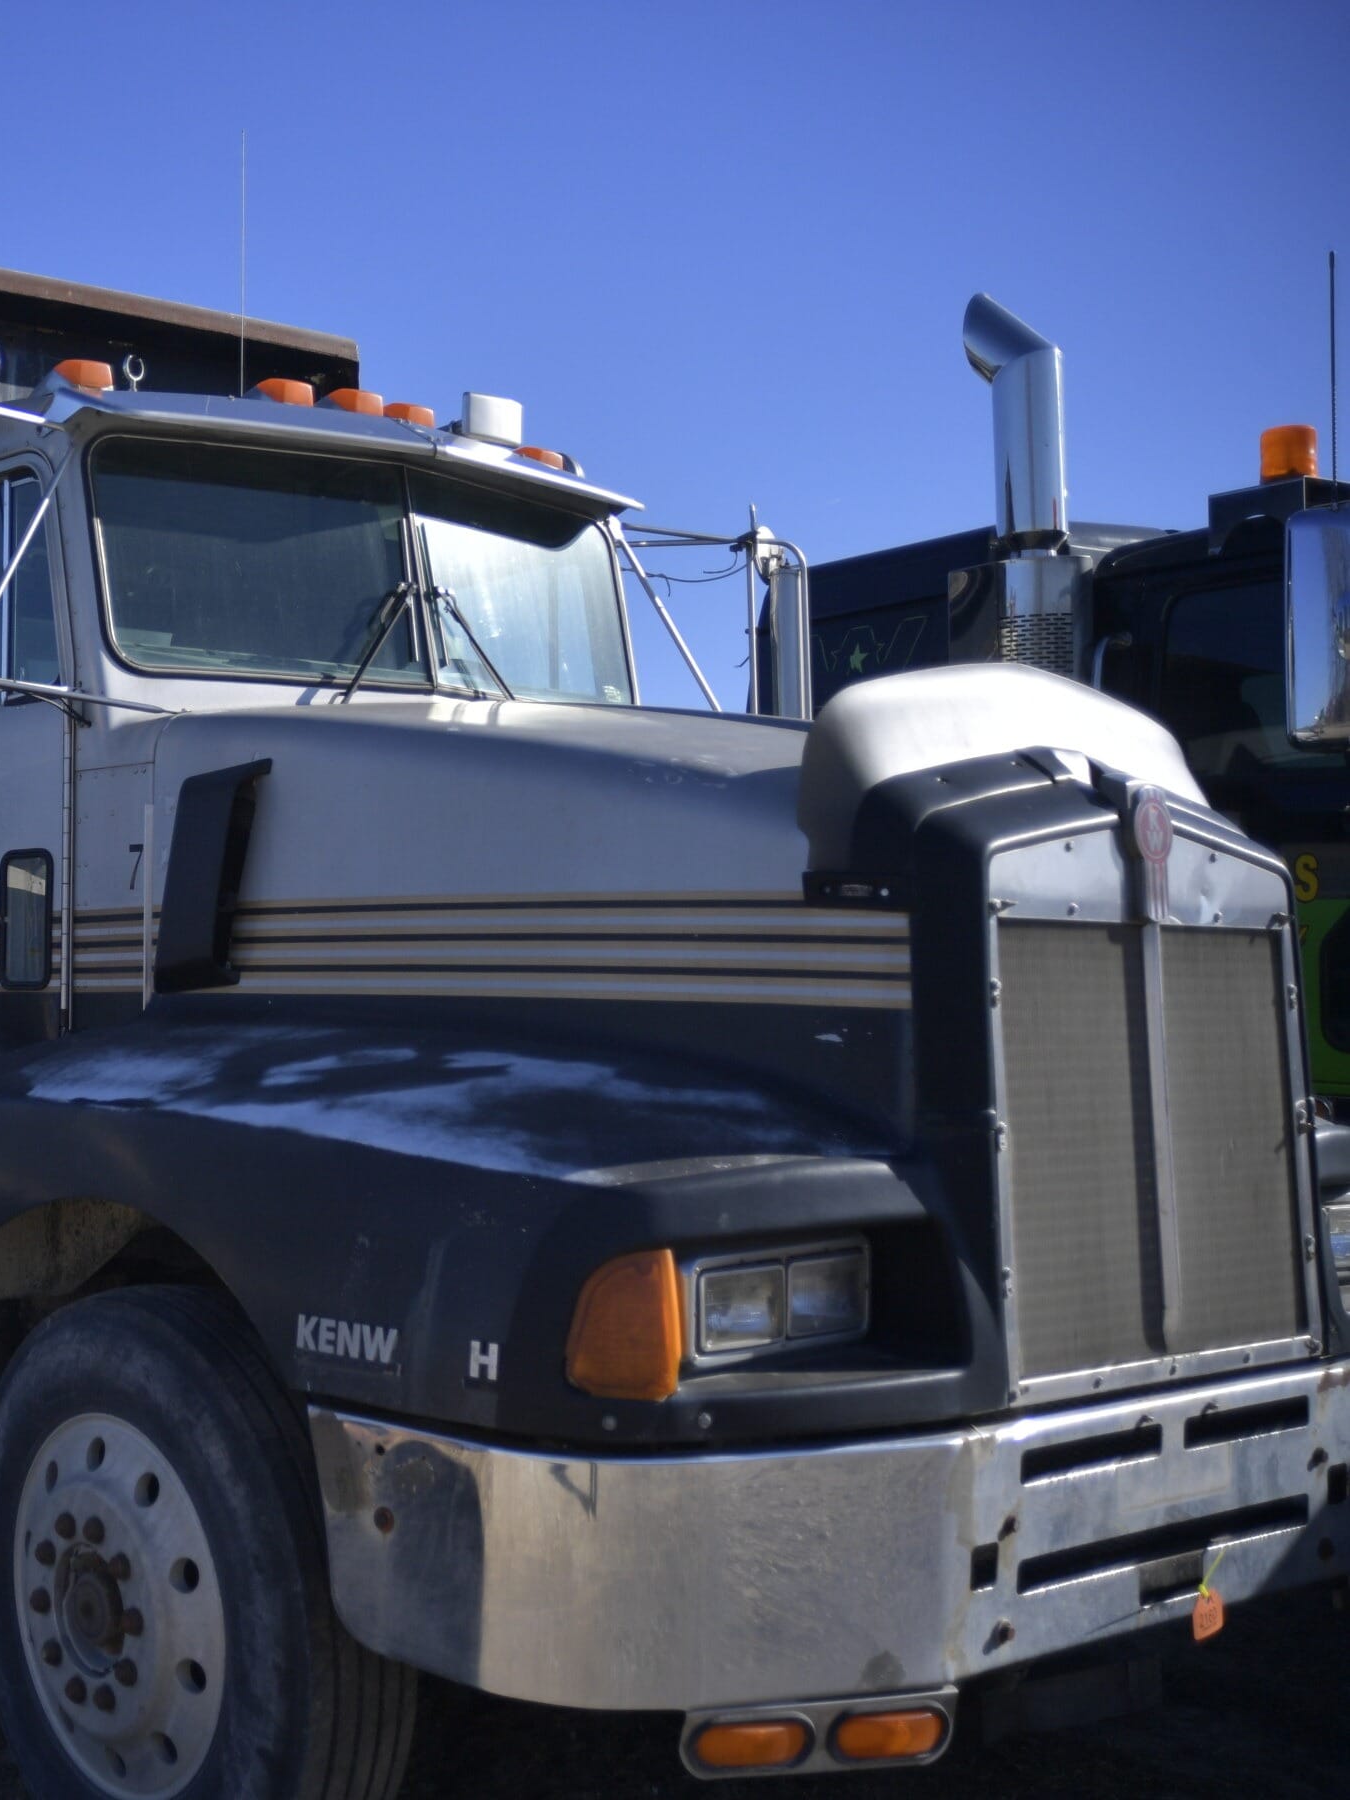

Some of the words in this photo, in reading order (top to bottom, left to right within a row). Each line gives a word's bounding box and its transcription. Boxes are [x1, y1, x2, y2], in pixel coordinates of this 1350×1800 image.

[129, 844, 144, 890] 7
[1281, 853, 1319, 903] S
[295, 1313, 399, 1364] KENW
[468, 1339, 499, 1381] H
